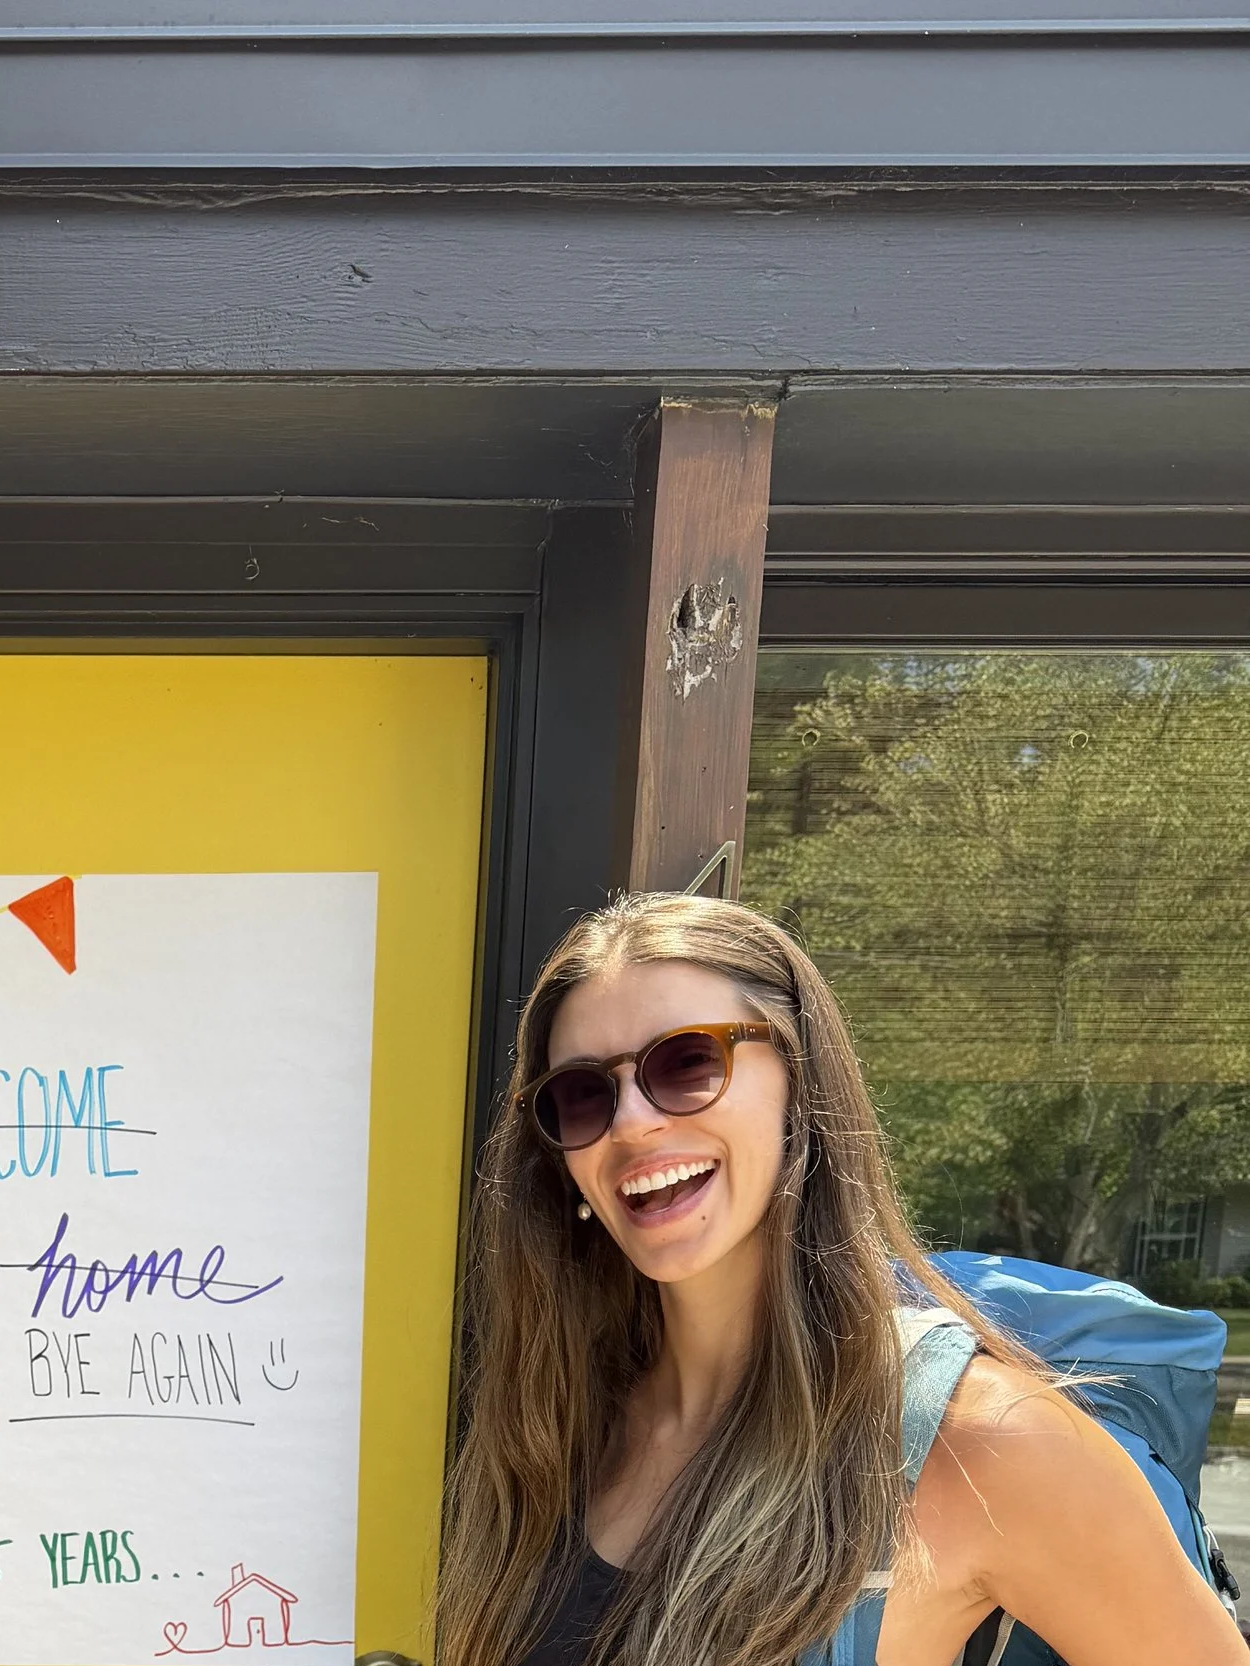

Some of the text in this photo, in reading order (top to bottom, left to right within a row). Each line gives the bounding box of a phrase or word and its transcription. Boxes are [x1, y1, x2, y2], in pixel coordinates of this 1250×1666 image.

[26, 1212, 284, 1319] home
[24, 1327, 242, 1406] BYE AGAIN
